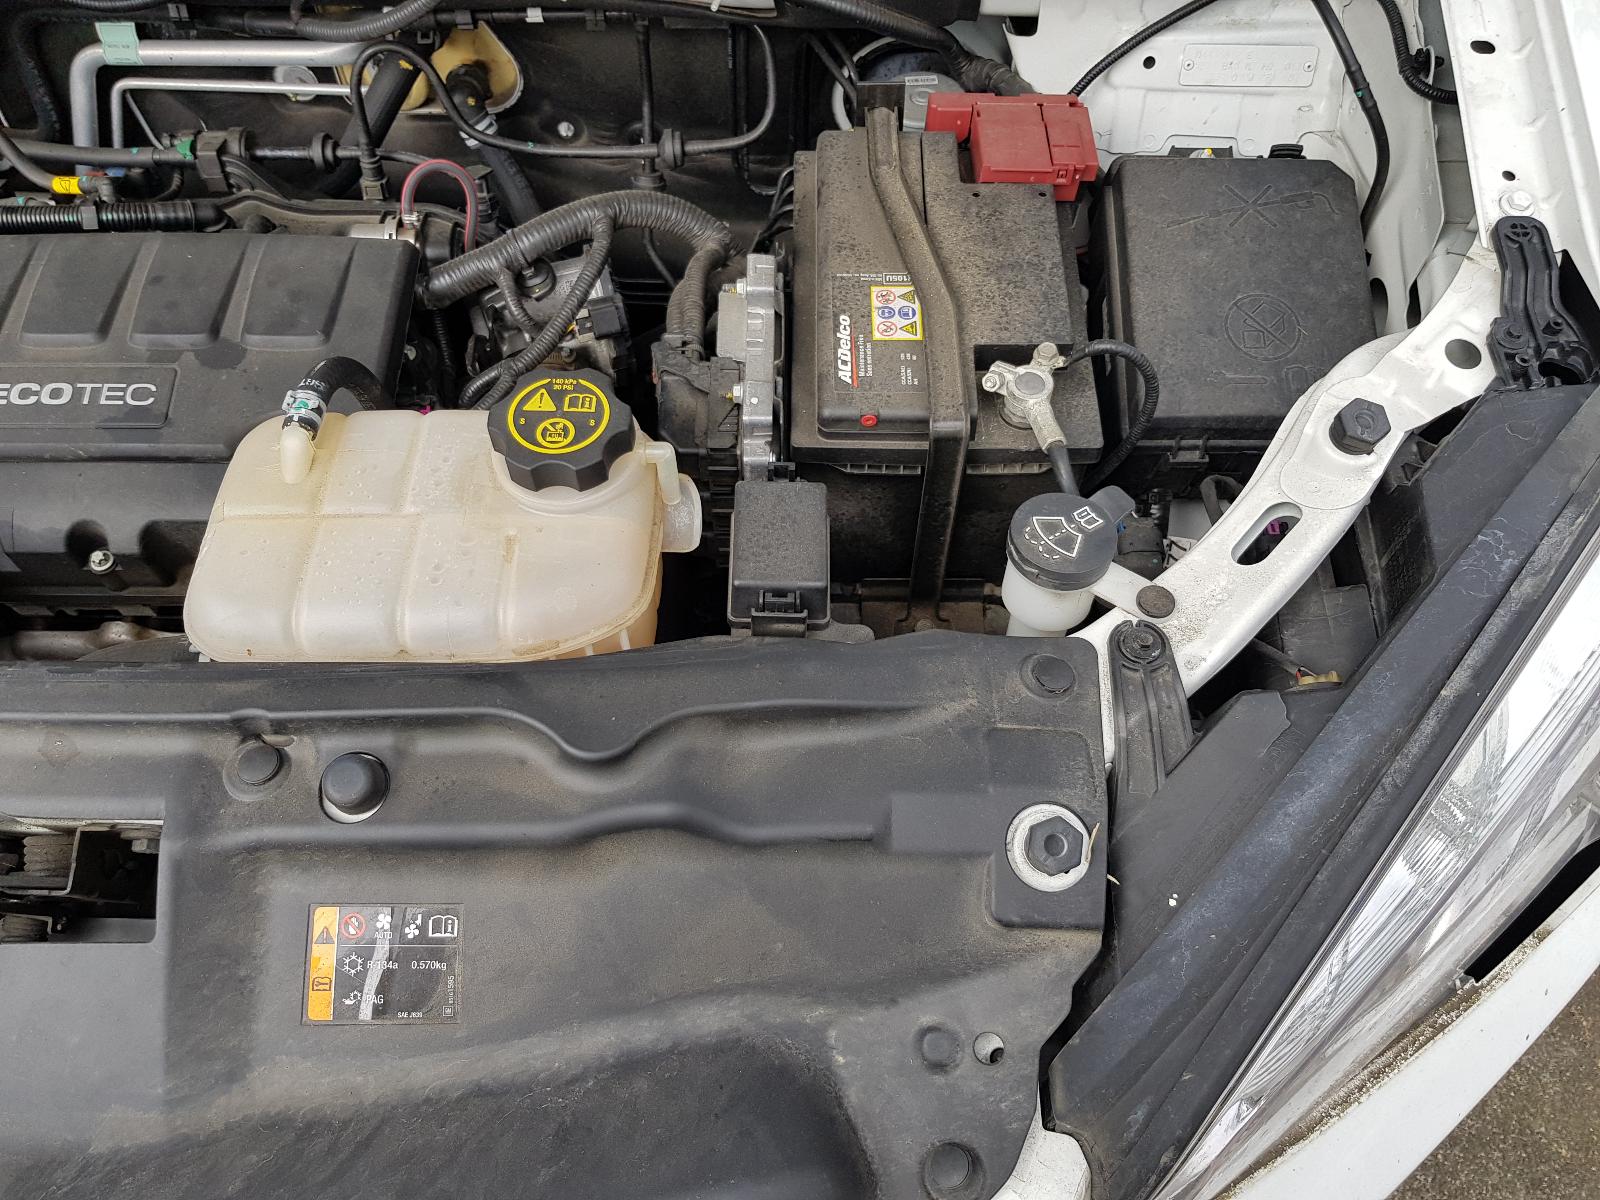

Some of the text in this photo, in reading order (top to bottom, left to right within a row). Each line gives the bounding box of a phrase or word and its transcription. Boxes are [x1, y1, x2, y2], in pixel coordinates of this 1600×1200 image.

[836, 315, 852, 385] ACDelco
[367, 961, 447, 970] R-134a 0.570kg
[366, 994, 384, 1003] PAG
